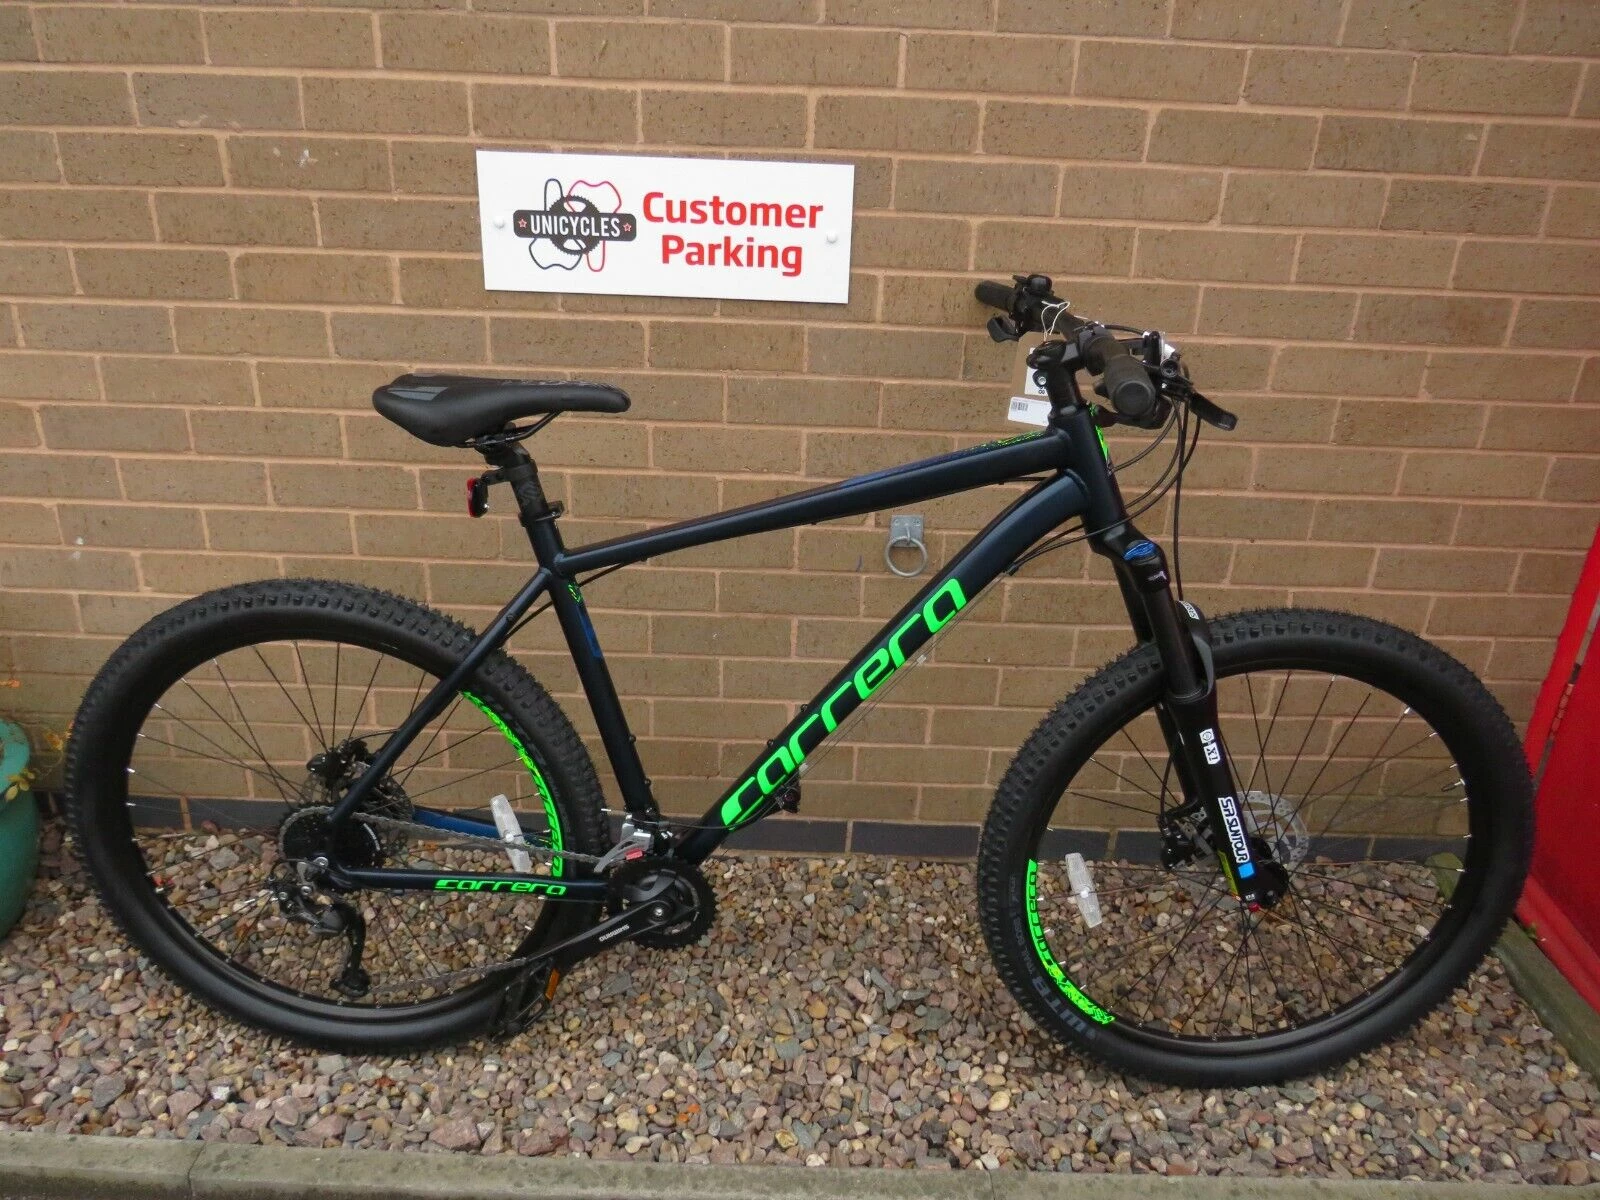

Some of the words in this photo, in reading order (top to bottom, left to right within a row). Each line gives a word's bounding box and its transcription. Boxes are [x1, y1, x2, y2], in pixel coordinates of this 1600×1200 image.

[530, 214, 621, 238] UNICYCLES
[643, 192, 823, 228] Customer
[662, 235, 803, 277] Parking
[1225, 818, 1249, 863] SUNTOUR
